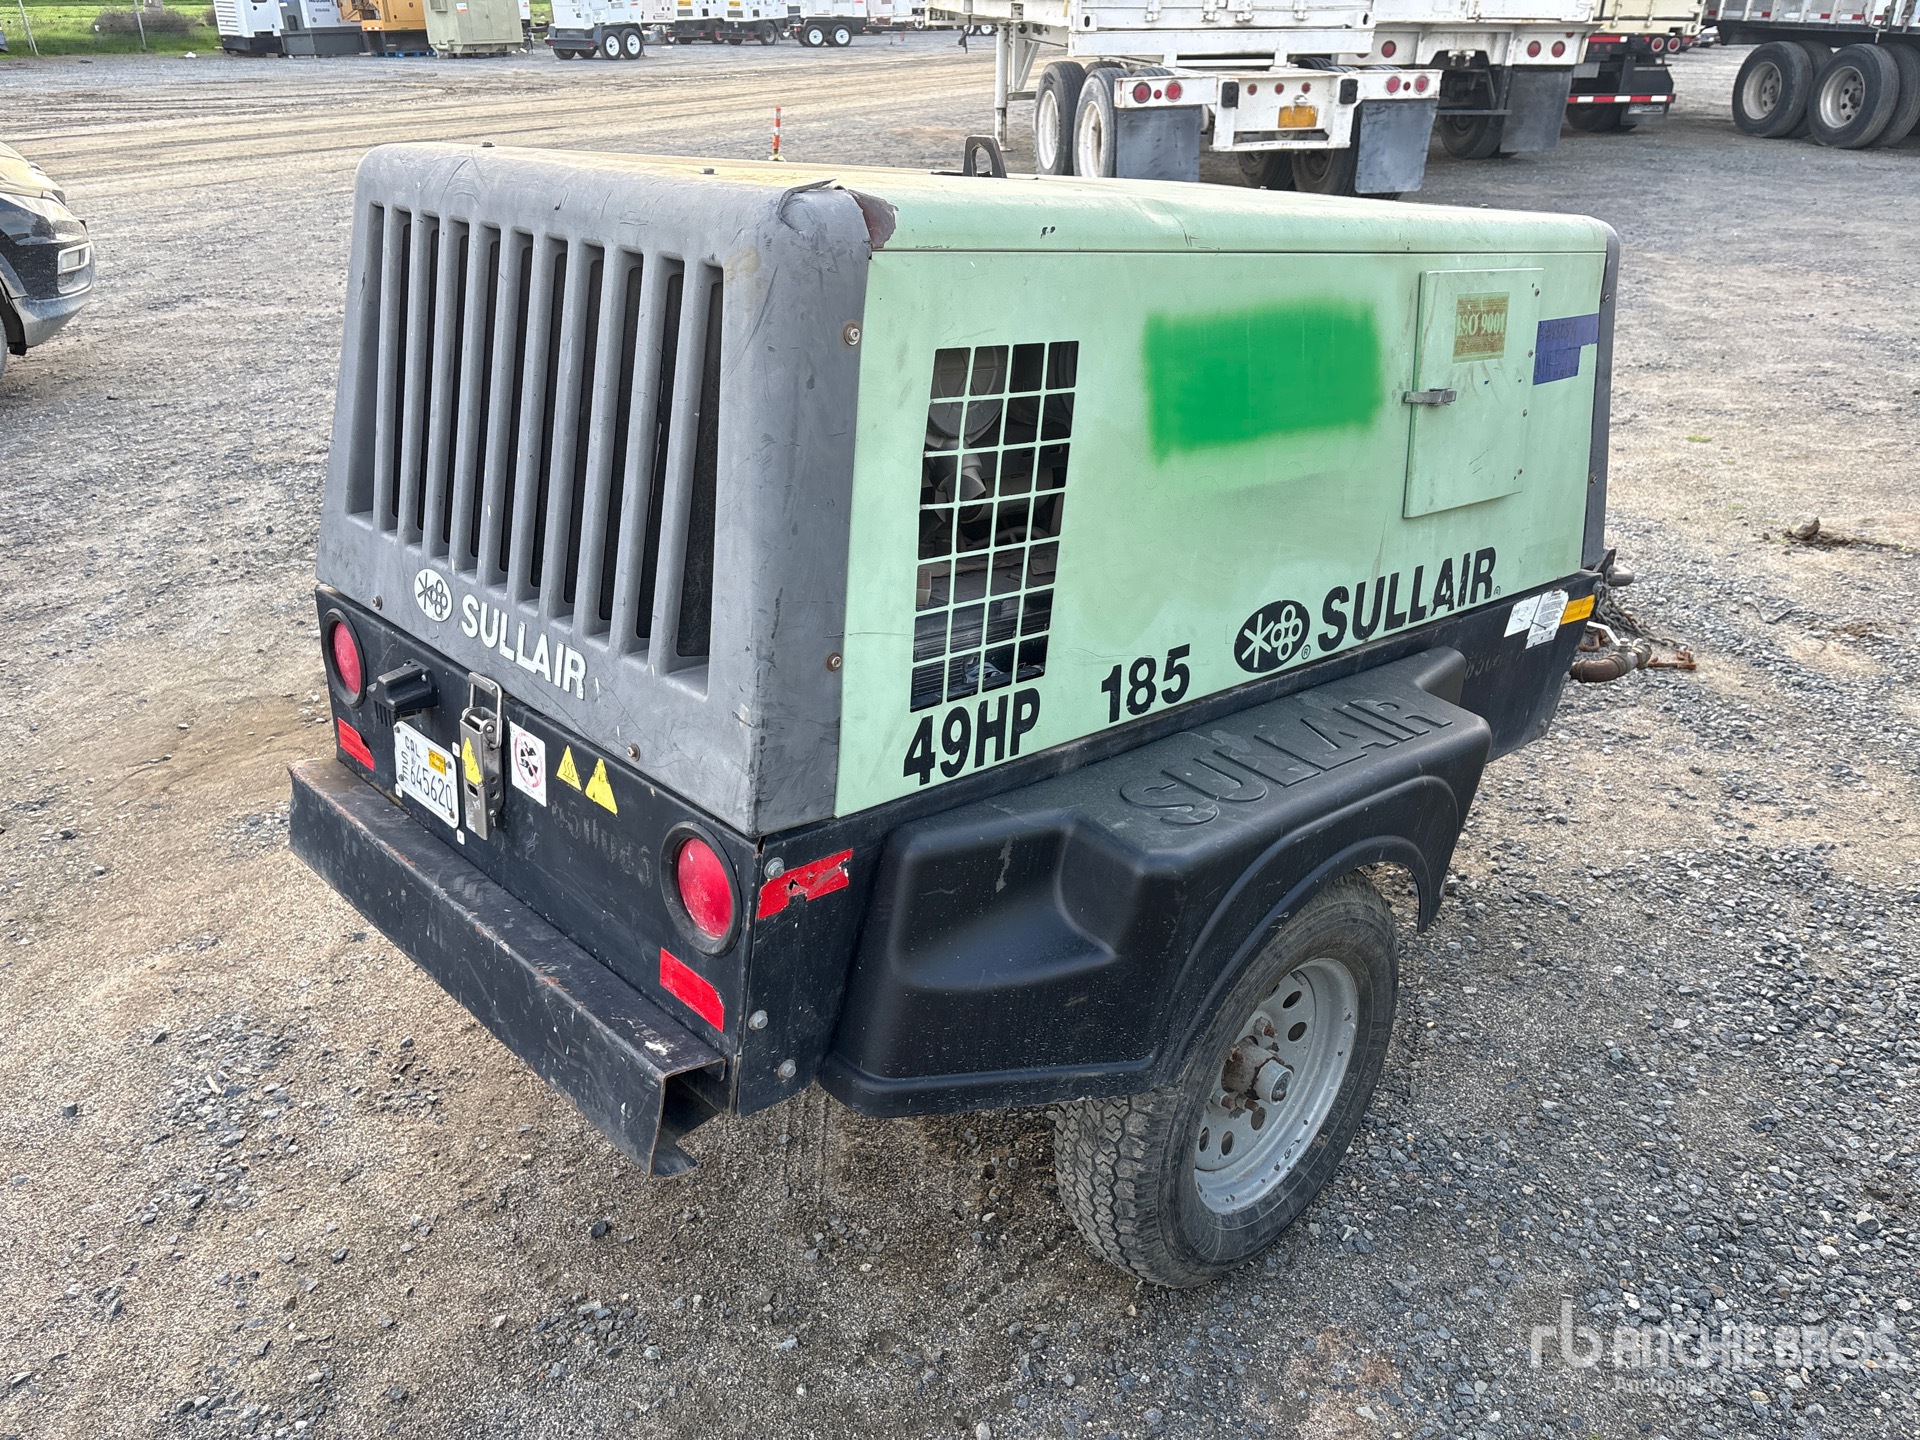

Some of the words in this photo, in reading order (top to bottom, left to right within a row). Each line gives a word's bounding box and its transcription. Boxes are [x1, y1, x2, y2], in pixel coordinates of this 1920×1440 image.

[1457, 313, 1480, 336] ISO
[1481, 312, 1506, 335] 9001
[1318, 546, 1495, 652] SULLAIR
[461, 593, 588, 700] SULLAIR
[1101, 644, 1191, 724] 185
[404, 735, 421, 758] CAL
[903, 687, 1041, 786] 49HP
[1120, 692, 1453, 826] SULLAIR
[410, 763, 453, 811] 645620
